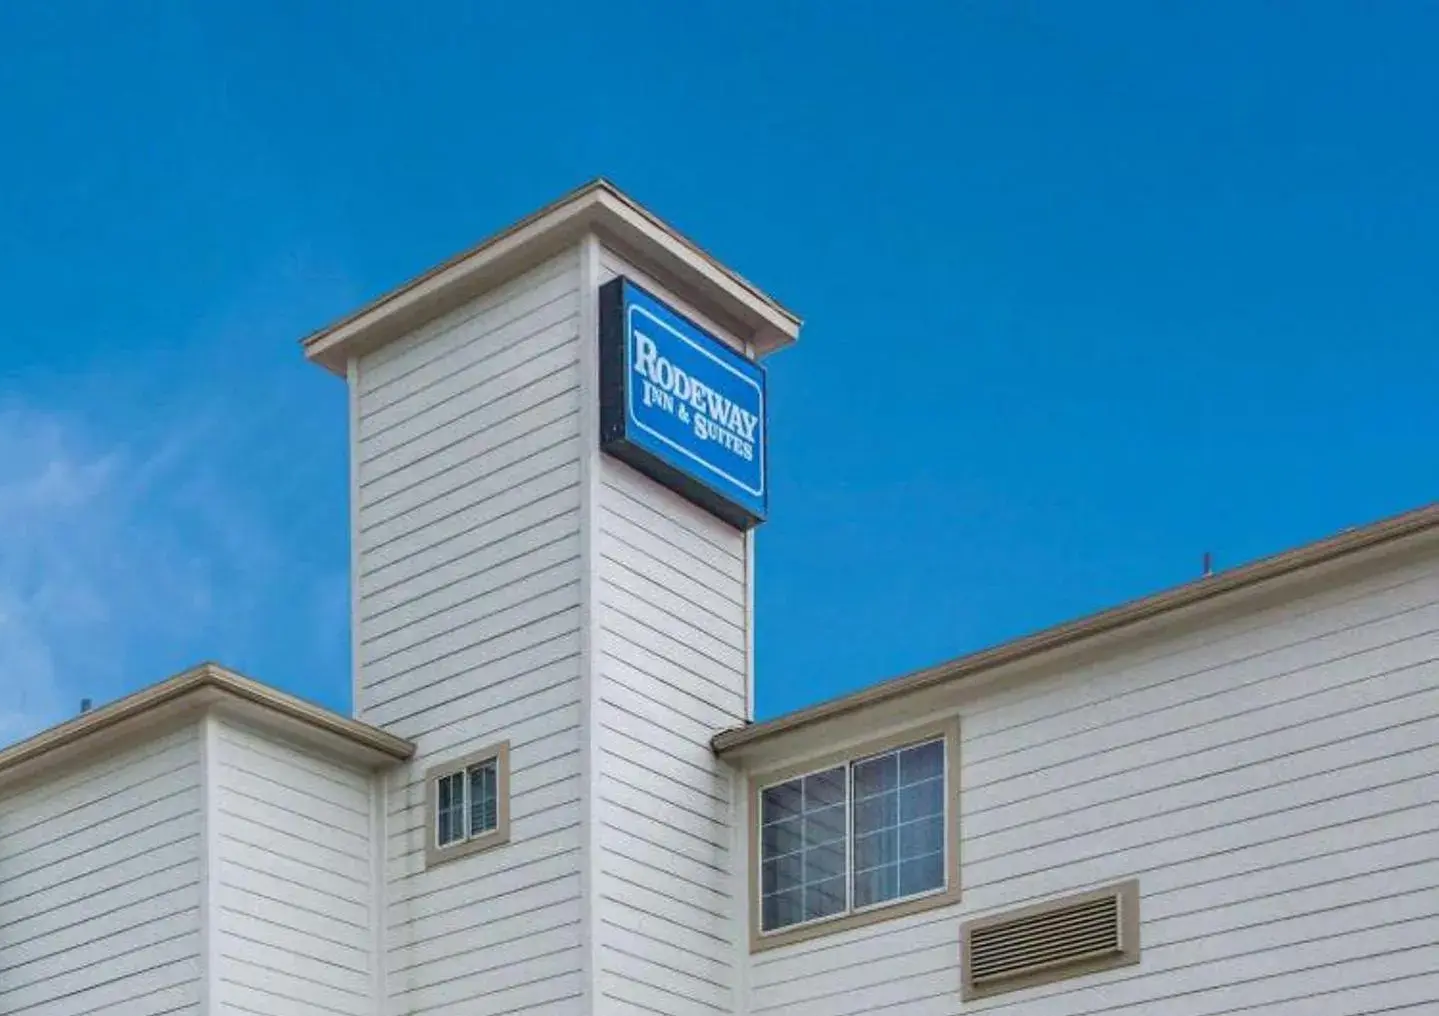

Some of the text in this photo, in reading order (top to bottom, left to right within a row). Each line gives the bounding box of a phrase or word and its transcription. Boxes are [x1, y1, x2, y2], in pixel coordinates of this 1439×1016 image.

[634, 330, 758, 443] RODEWAY
[642, 379, 674, 413] INN
[693, 413, 753, 462] SUITES
